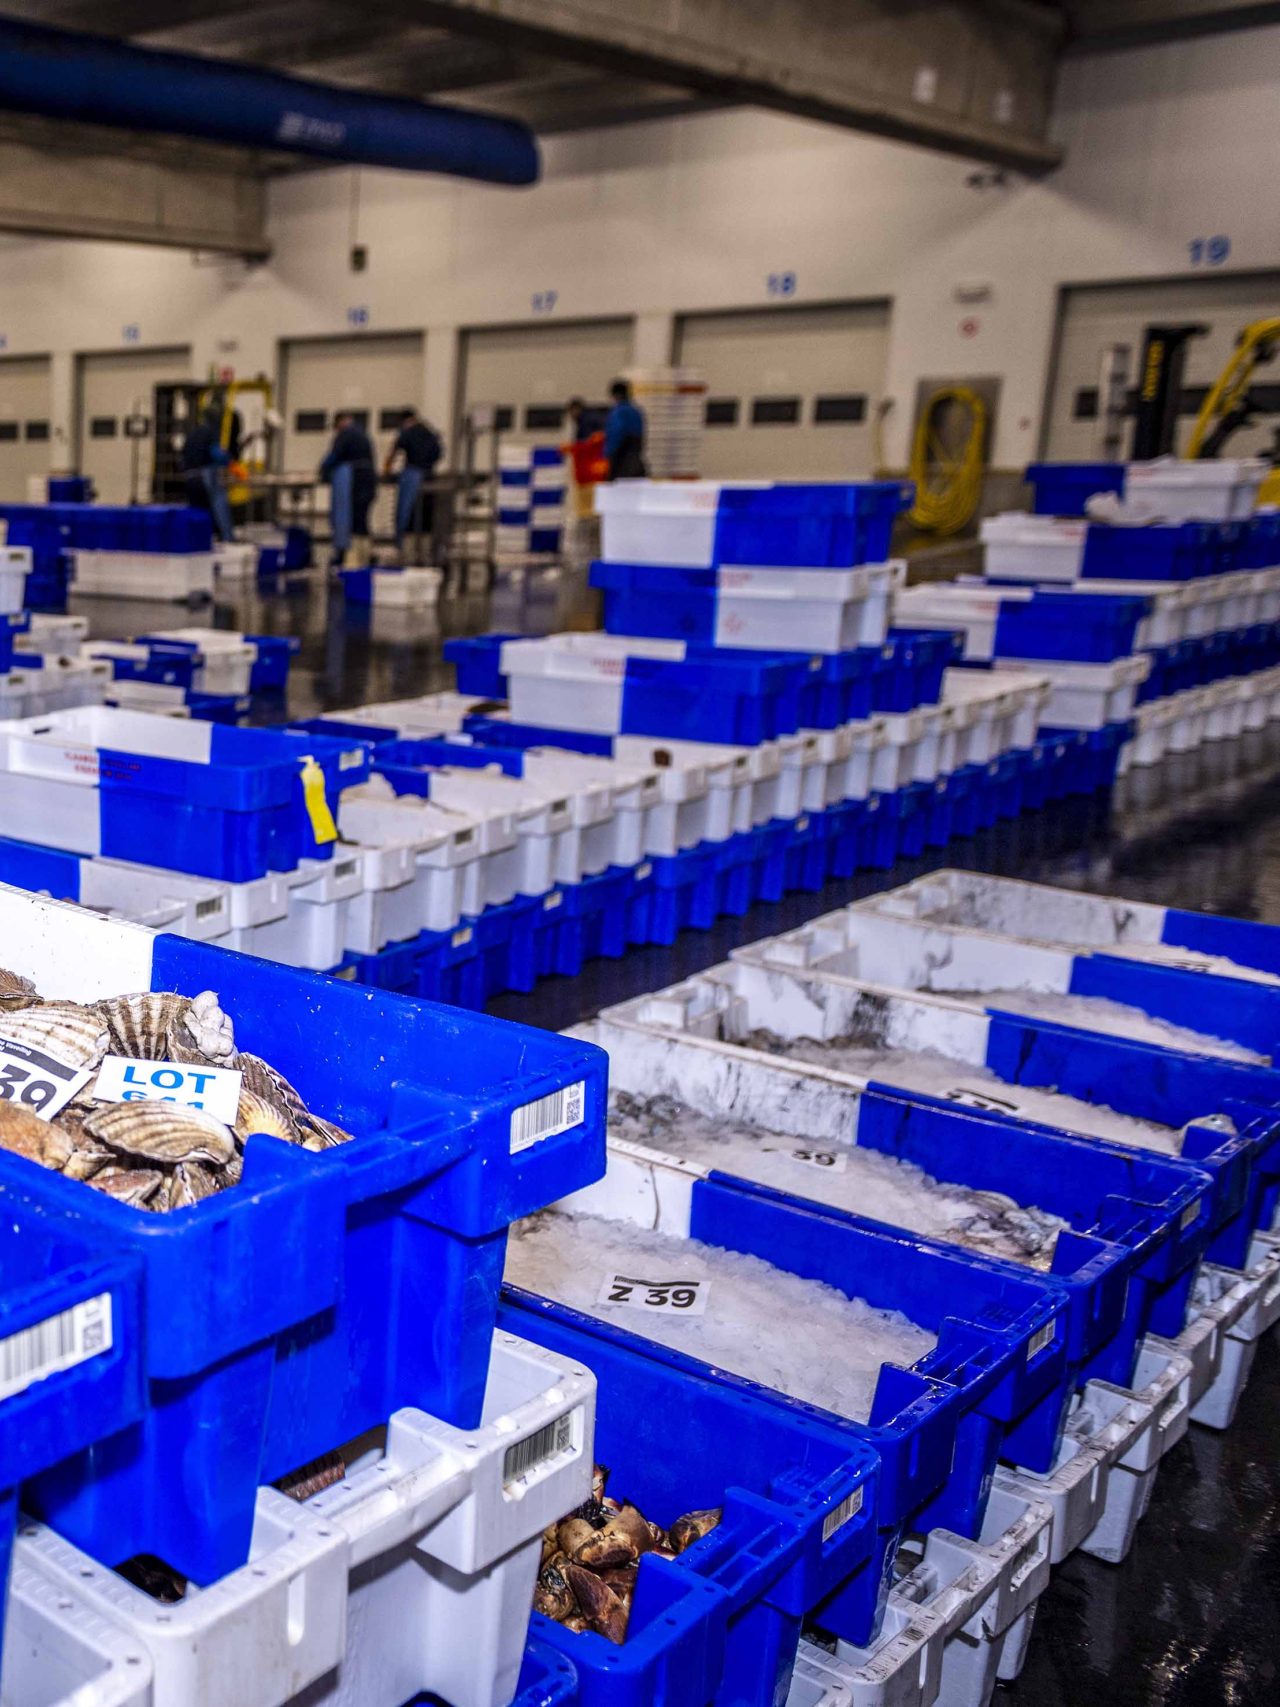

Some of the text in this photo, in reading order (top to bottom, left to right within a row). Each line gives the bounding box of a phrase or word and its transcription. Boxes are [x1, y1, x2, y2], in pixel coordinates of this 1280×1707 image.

[123, 1065, 217, 1094] LOT
[607, 1284, 697, 1308] Z 39
